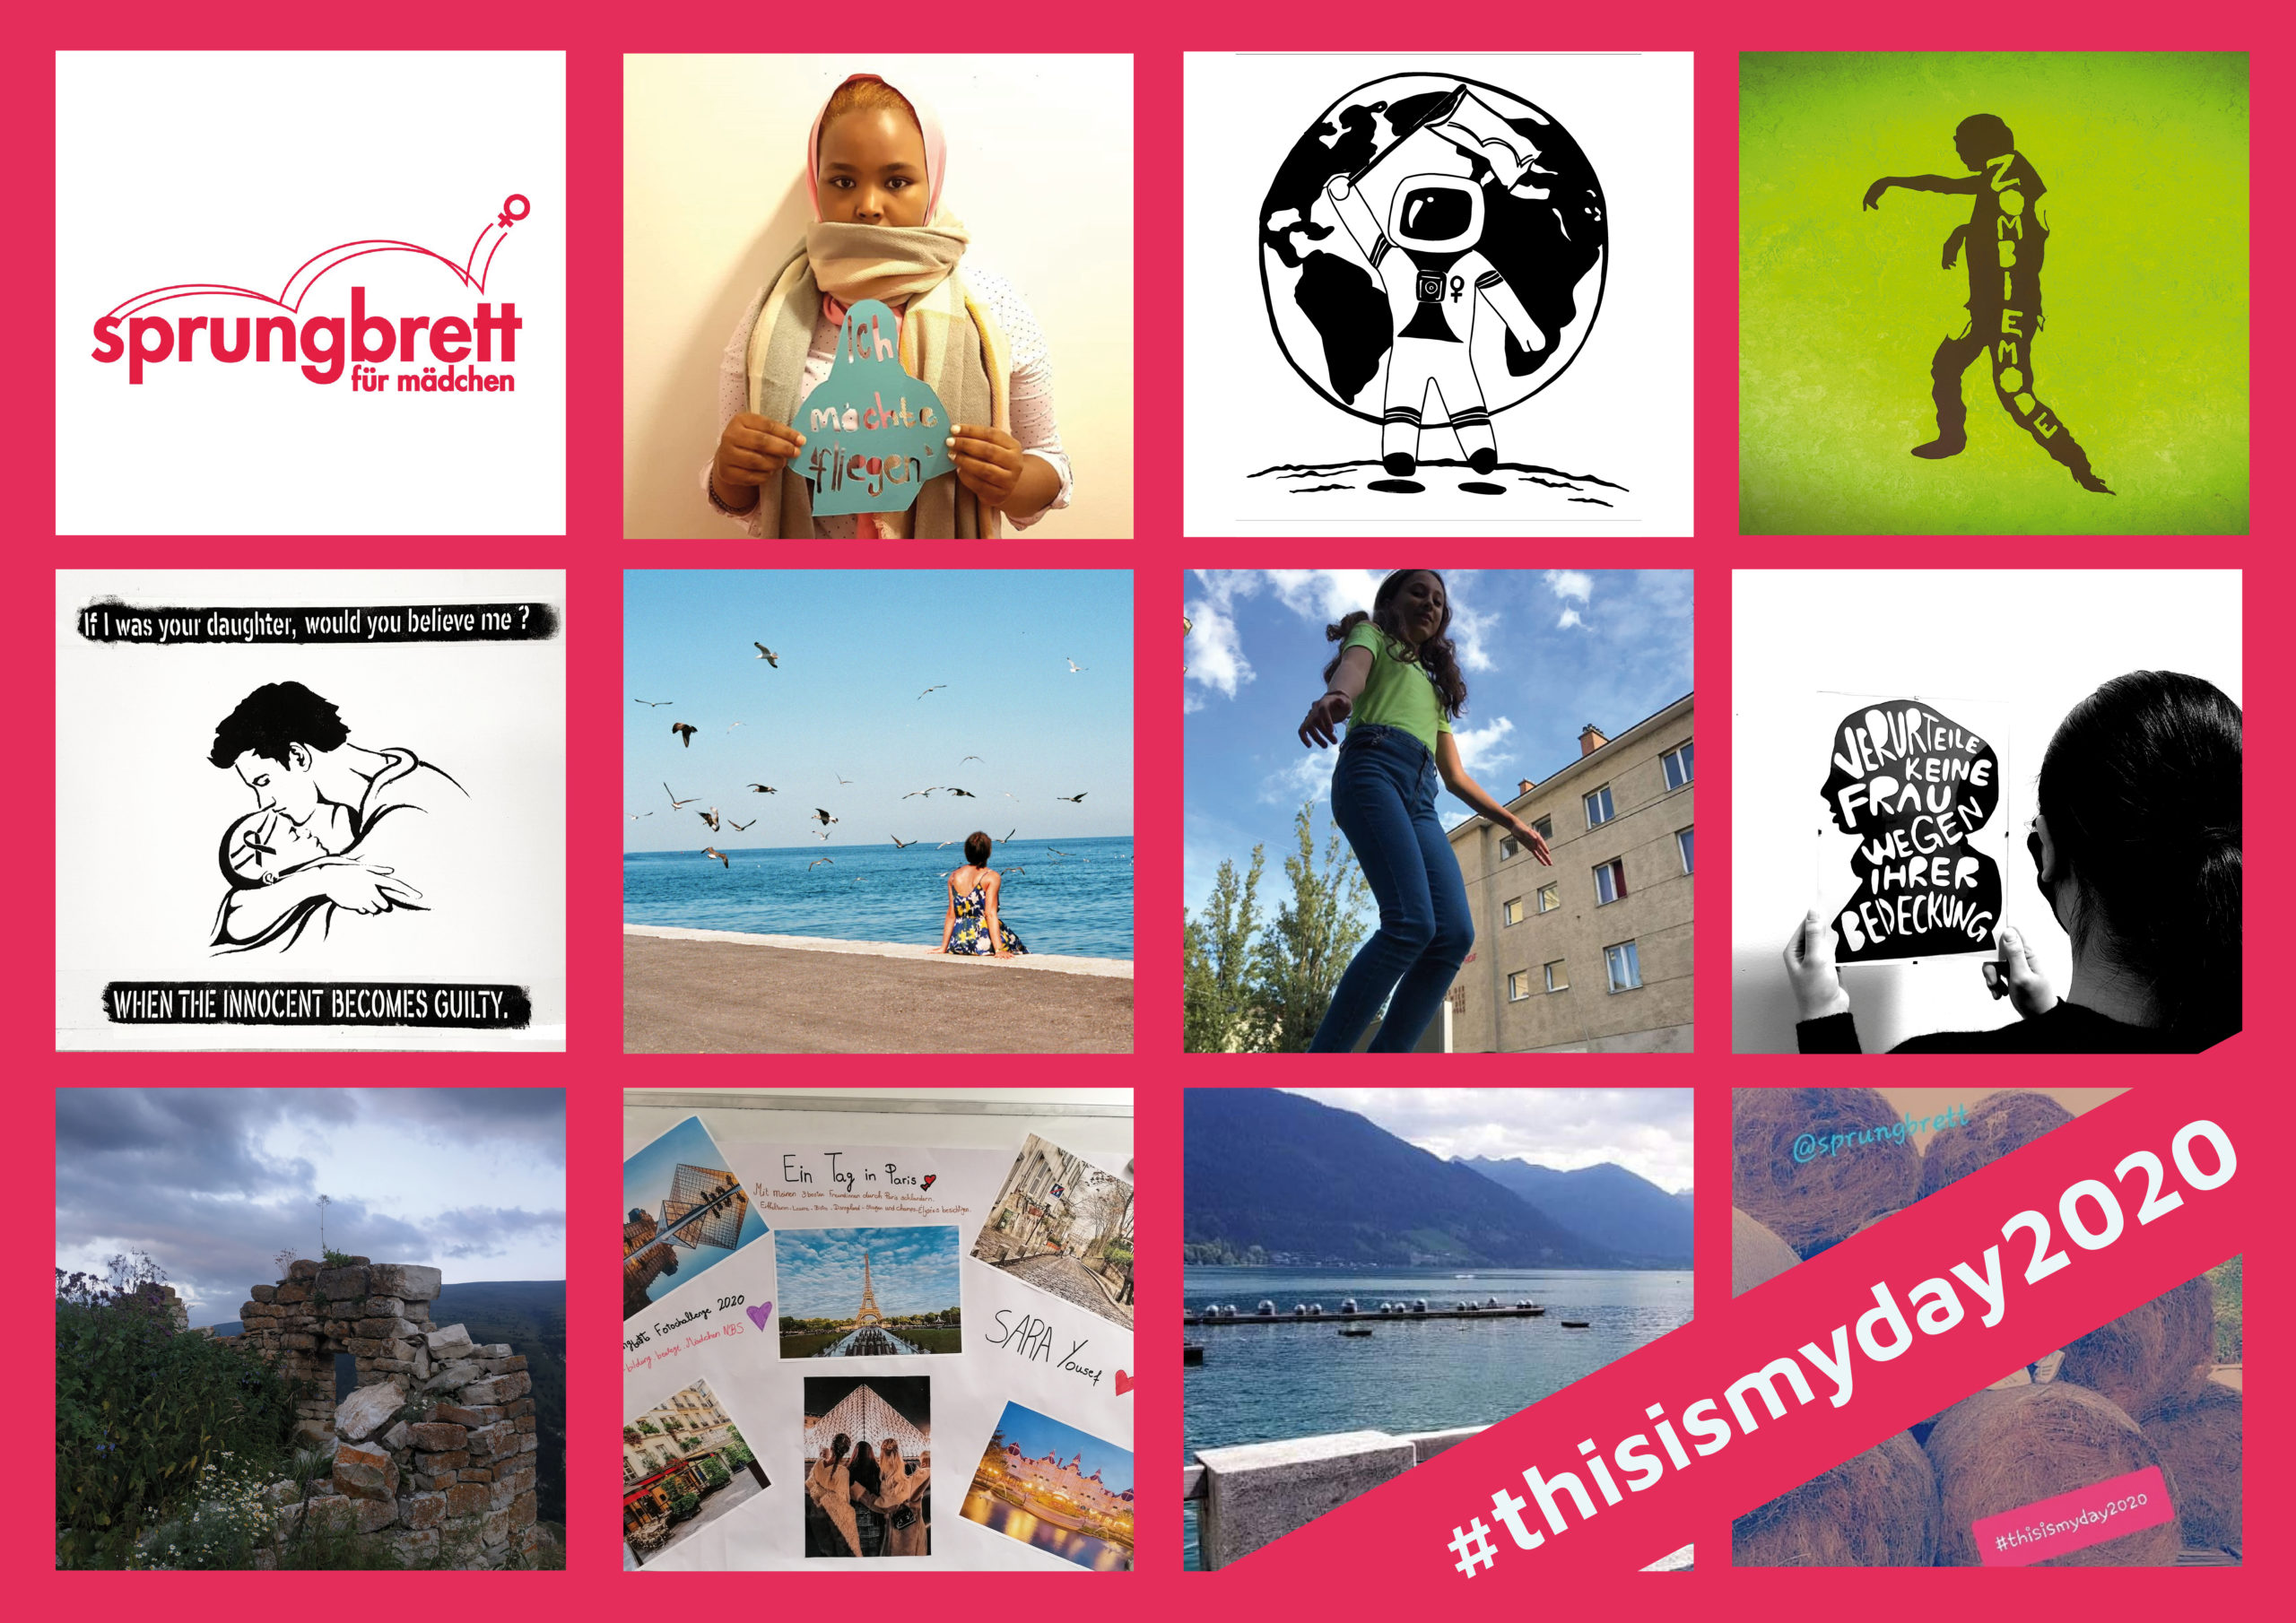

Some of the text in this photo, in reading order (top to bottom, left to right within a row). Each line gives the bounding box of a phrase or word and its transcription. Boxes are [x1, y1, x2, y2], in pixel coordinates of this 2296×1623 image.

[91, 287, 522, 385] sprungbrett
[352, 364, 515, 392] für mädchen
[84, 612, 98, 636] If
[104, 612, 109, 636] I
[116, 618, 152, 636] was
[158, 617, 202, 642] your
[207, 611, 297, 642] daughter,
[305, 609, 361, 634] would
[368, 615, 401, 639] you
[408, 607, 474, 632] believe
[482, 612, 512, 630] me
[1834, 707, 1980, 779] VERURTEILE
[1905, 757, 1993, 786] KEINE
[1838, 776, 1952, 829] FRAU
[1861, 795, 1984, 865] WEGEN
[1871, 855, 1979, 895] IHRER
[1840, 890, 1993, 951] BEDECKUNG
[114, 989, 509, 1019] WHEN THE INNOCENT BECOMES GUILTY.
[753, 1183, 770, 1197] Mit
[783, 1151, 917, 1193] Ein Tag in Paris
[717, 1294, 745, 1311] 2020
[985, 1309, 1103, 1387] SARA Yousef
